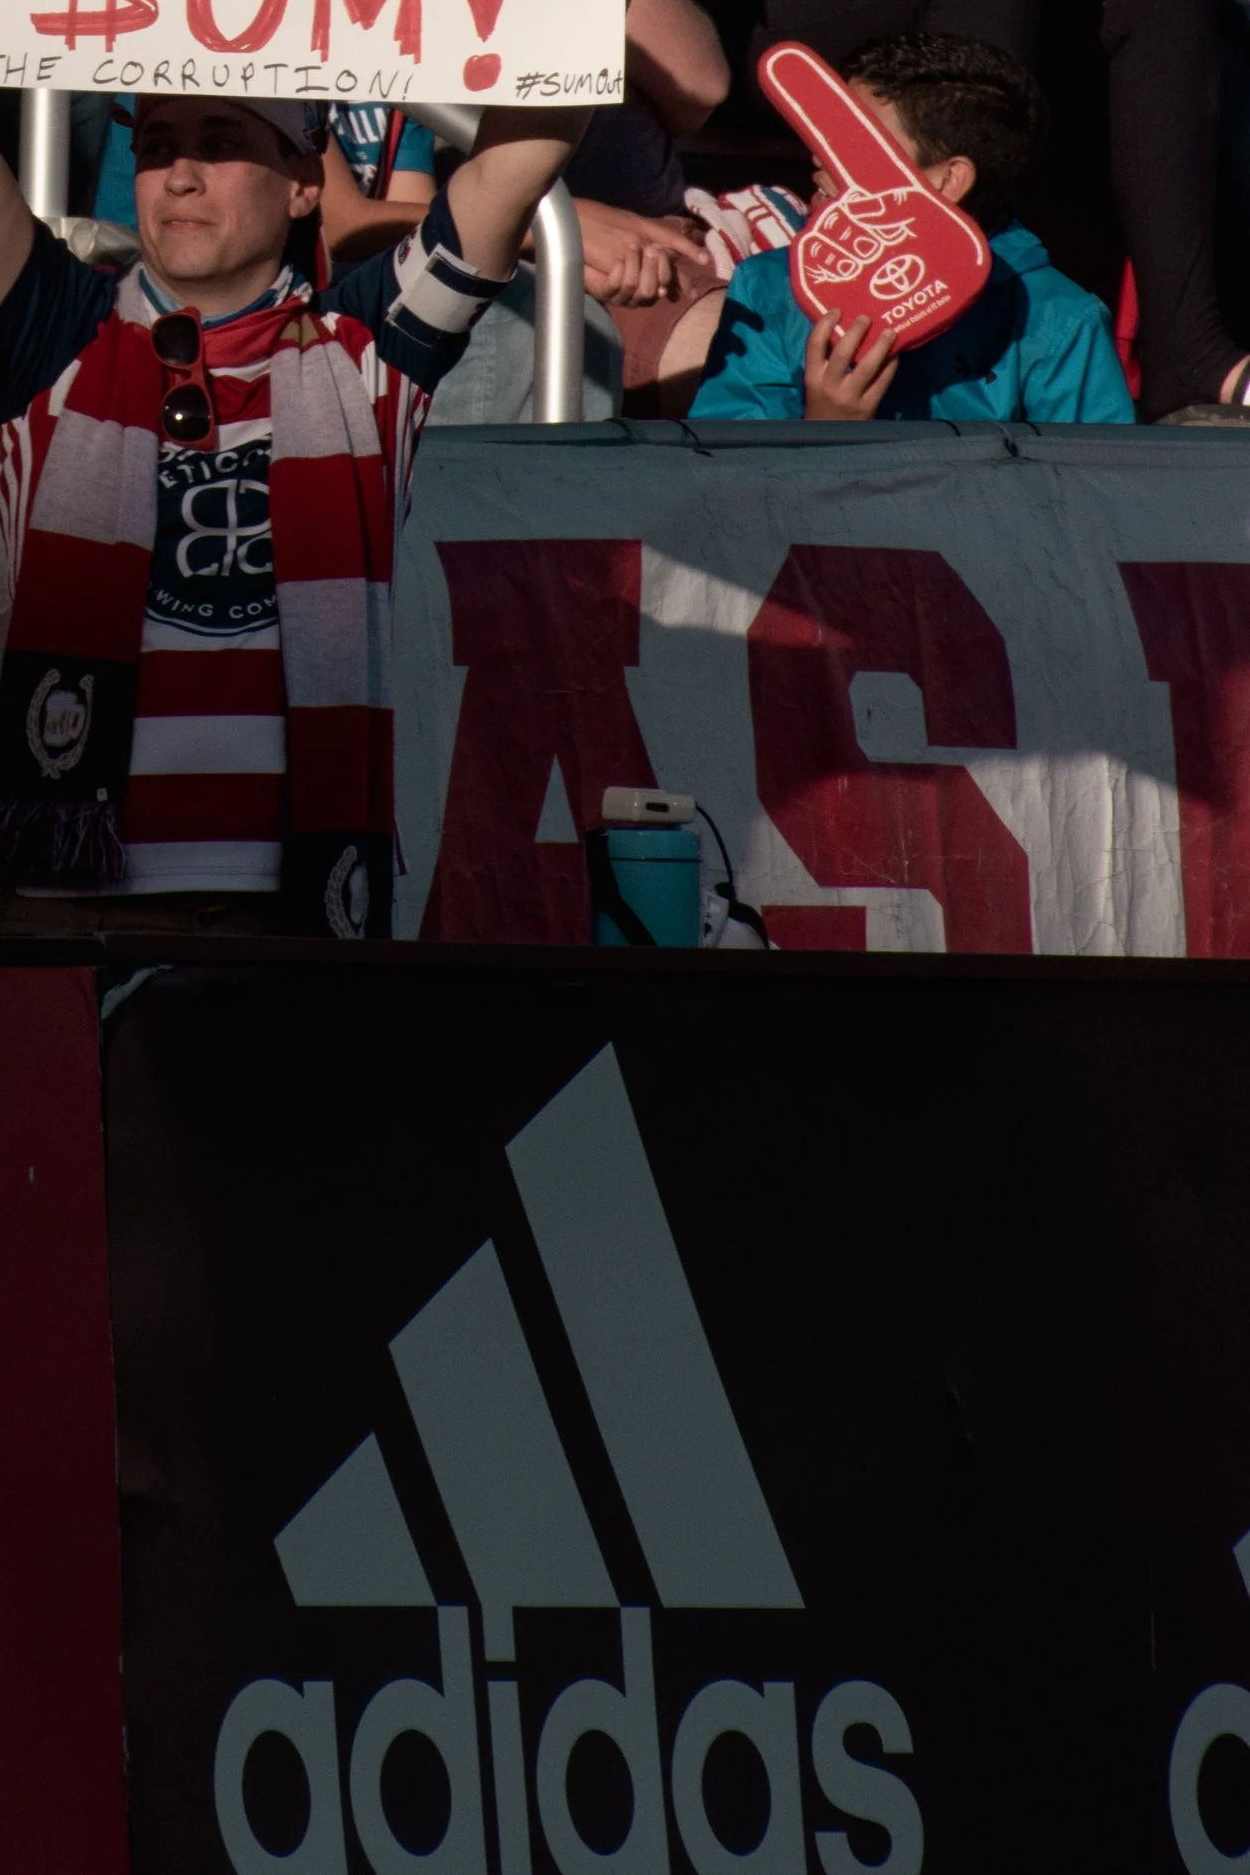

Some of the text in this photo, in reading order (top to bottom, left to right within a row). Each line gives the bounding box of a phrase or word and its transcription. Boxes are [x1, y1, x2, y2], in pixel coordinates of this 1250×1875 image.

[91, 57, 415, 101] CORRUPTION!
[881, 279, 948, 326] TOYOTA
[154, 588, 215, 618] WING
[213, 1605, 925, 1875] adidas
